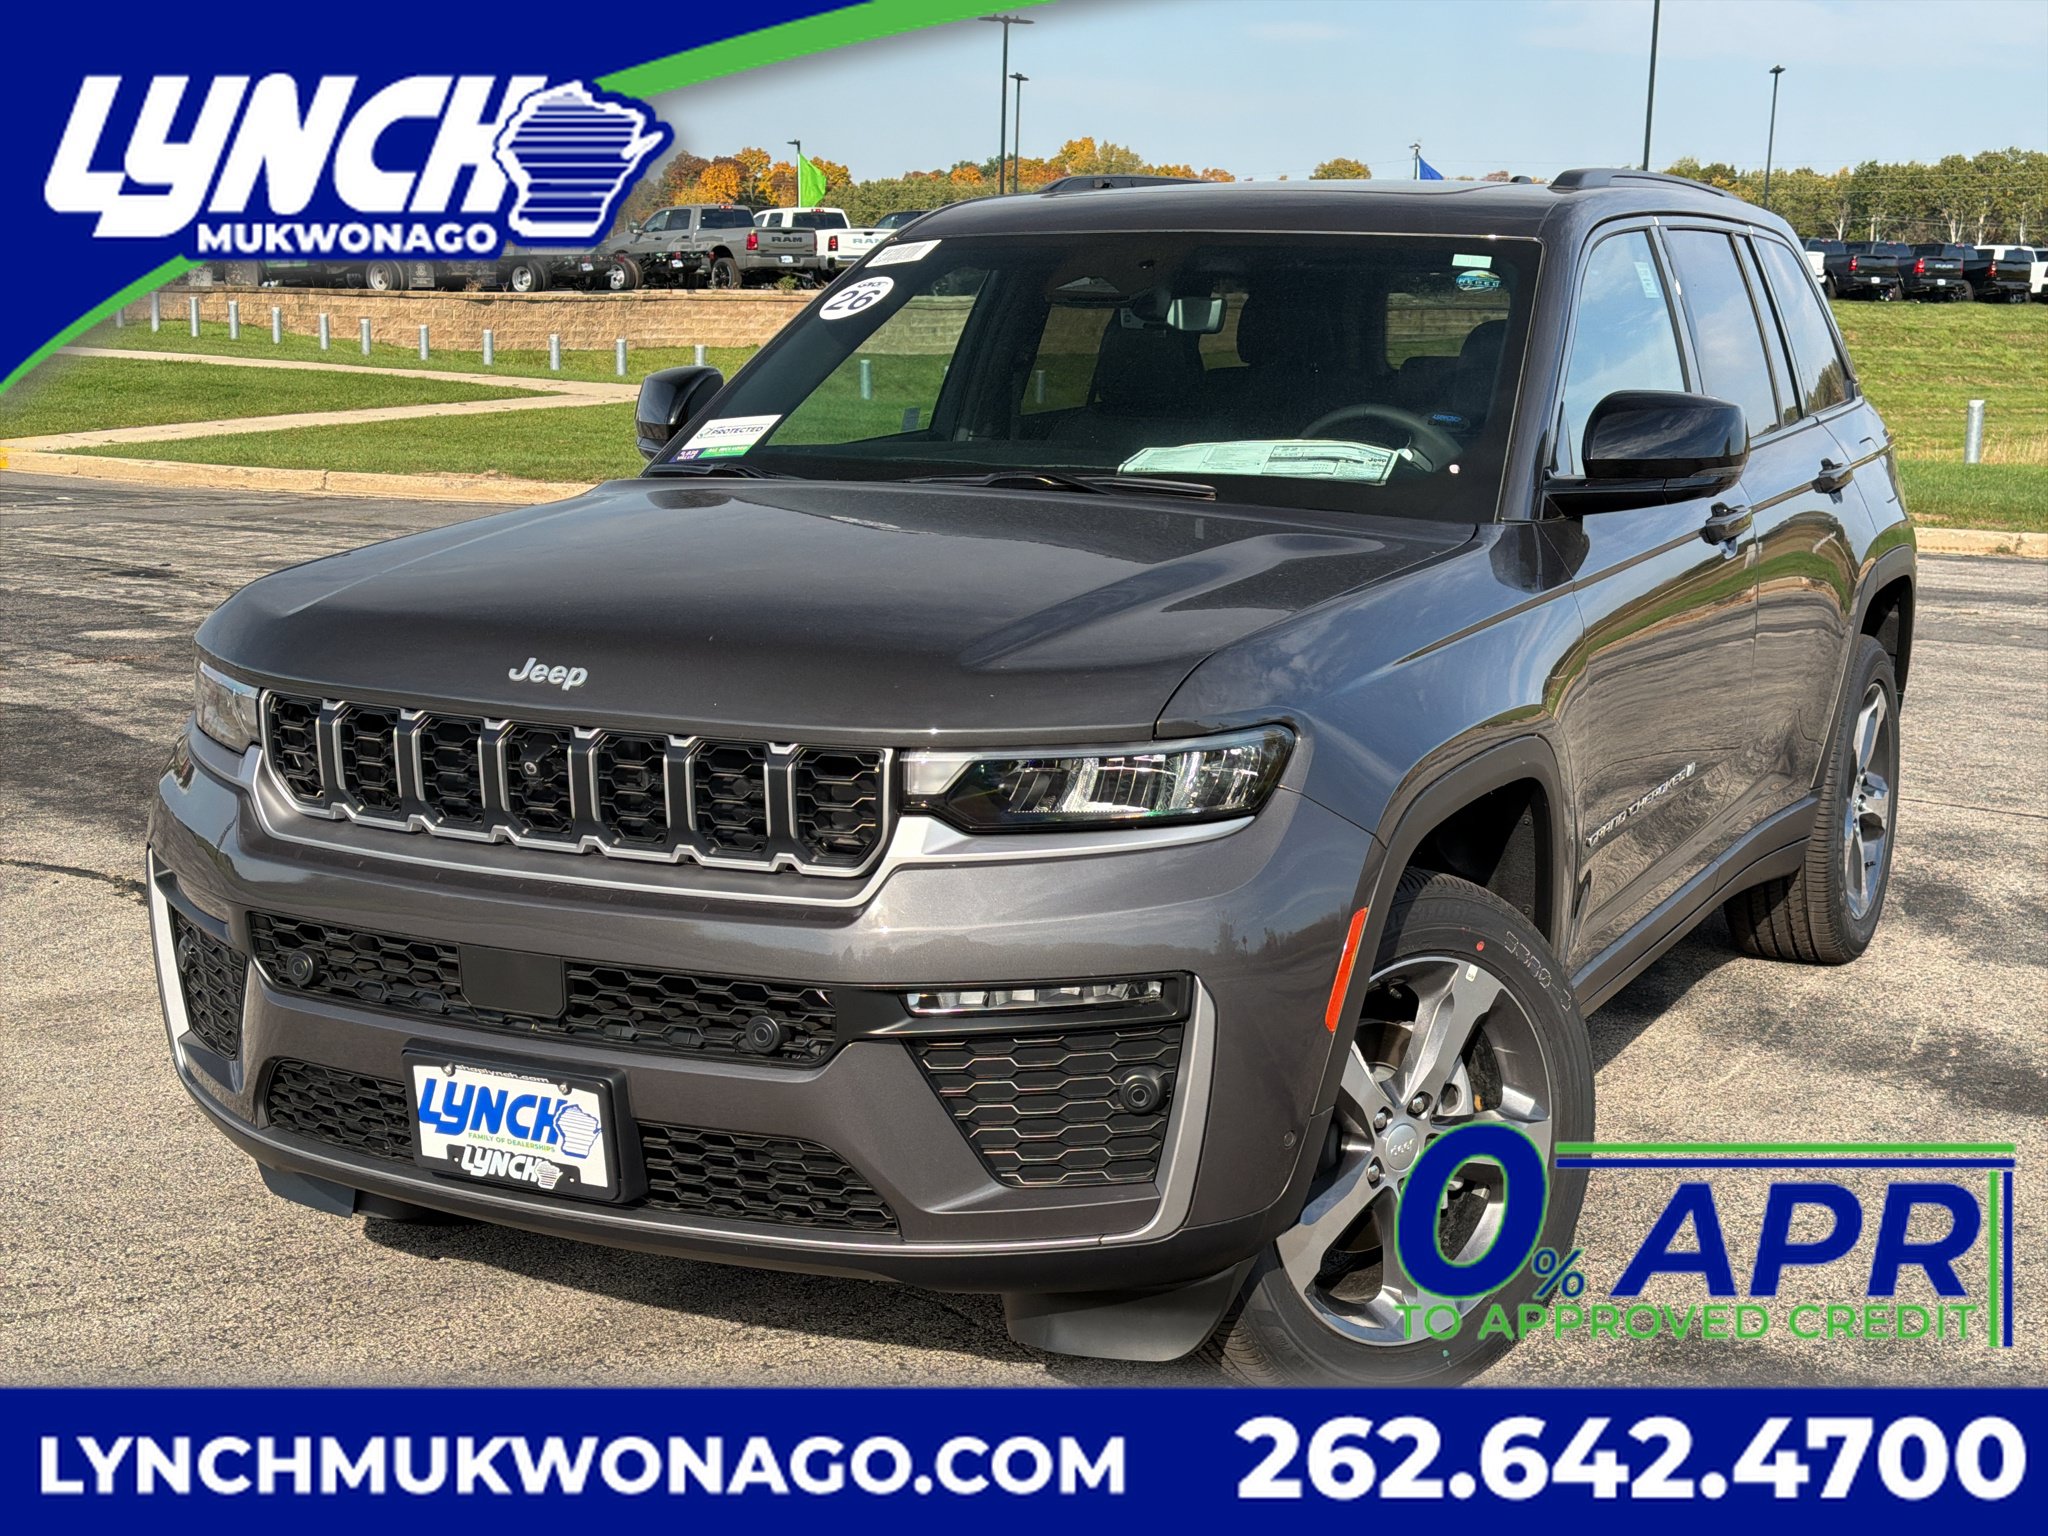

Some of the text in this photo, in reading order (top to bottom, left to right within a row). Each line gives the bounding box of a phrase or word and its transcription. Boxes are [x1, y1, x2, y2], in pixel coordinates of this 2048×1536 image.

[824, 289, 881, 311] 26
[712, 425, 764, 436] PROTECTED
[507, 657, 589, 691] Jeep
[418, 1078, 568, 1145] LYNCH
[468, 1132, 556, 1153] FAMILY OF DEALERSHIPS
[460, 1146, 540, 1183] LYNCH
